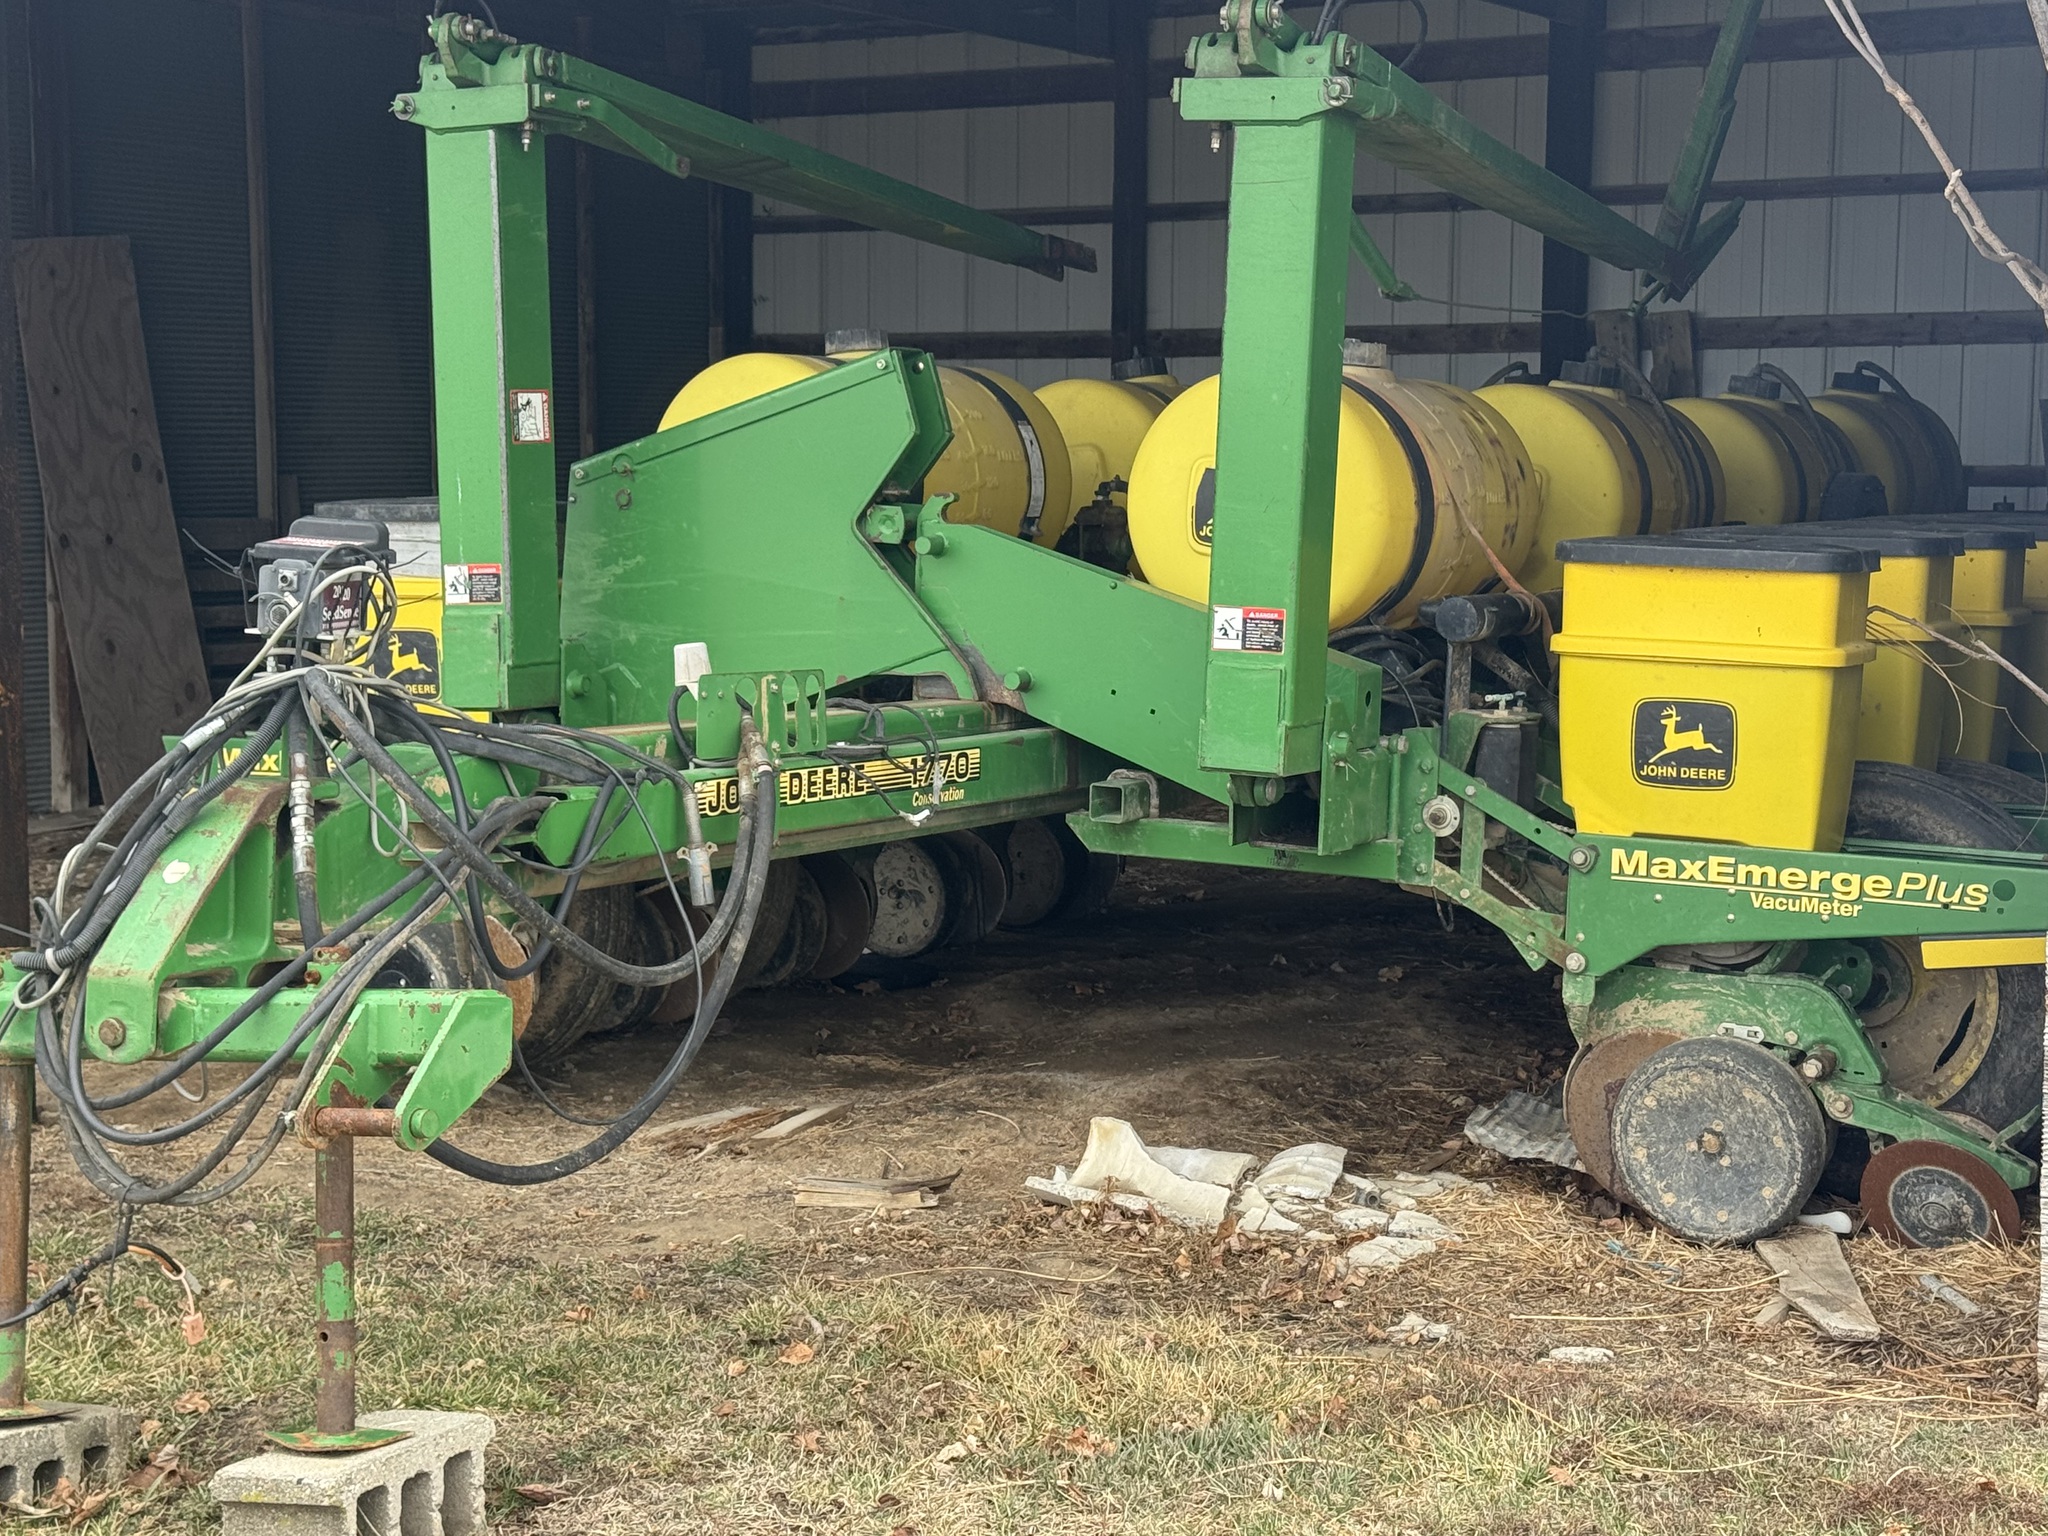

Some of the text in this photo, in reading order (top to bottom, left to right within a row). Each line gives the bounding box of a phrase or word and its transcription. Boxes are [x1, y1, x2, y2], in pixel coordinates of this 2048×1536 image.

[1199, 525, 1213, 537] JO
[787, 764, 867, 804] DEERE
[910, 751, 970, 787] 1770
[1640, 765, 1727, 780] JOHN DEERE
[912, 786, 965, 807] Consvation
[1750, 891, 1863, 918] VacuMeter
